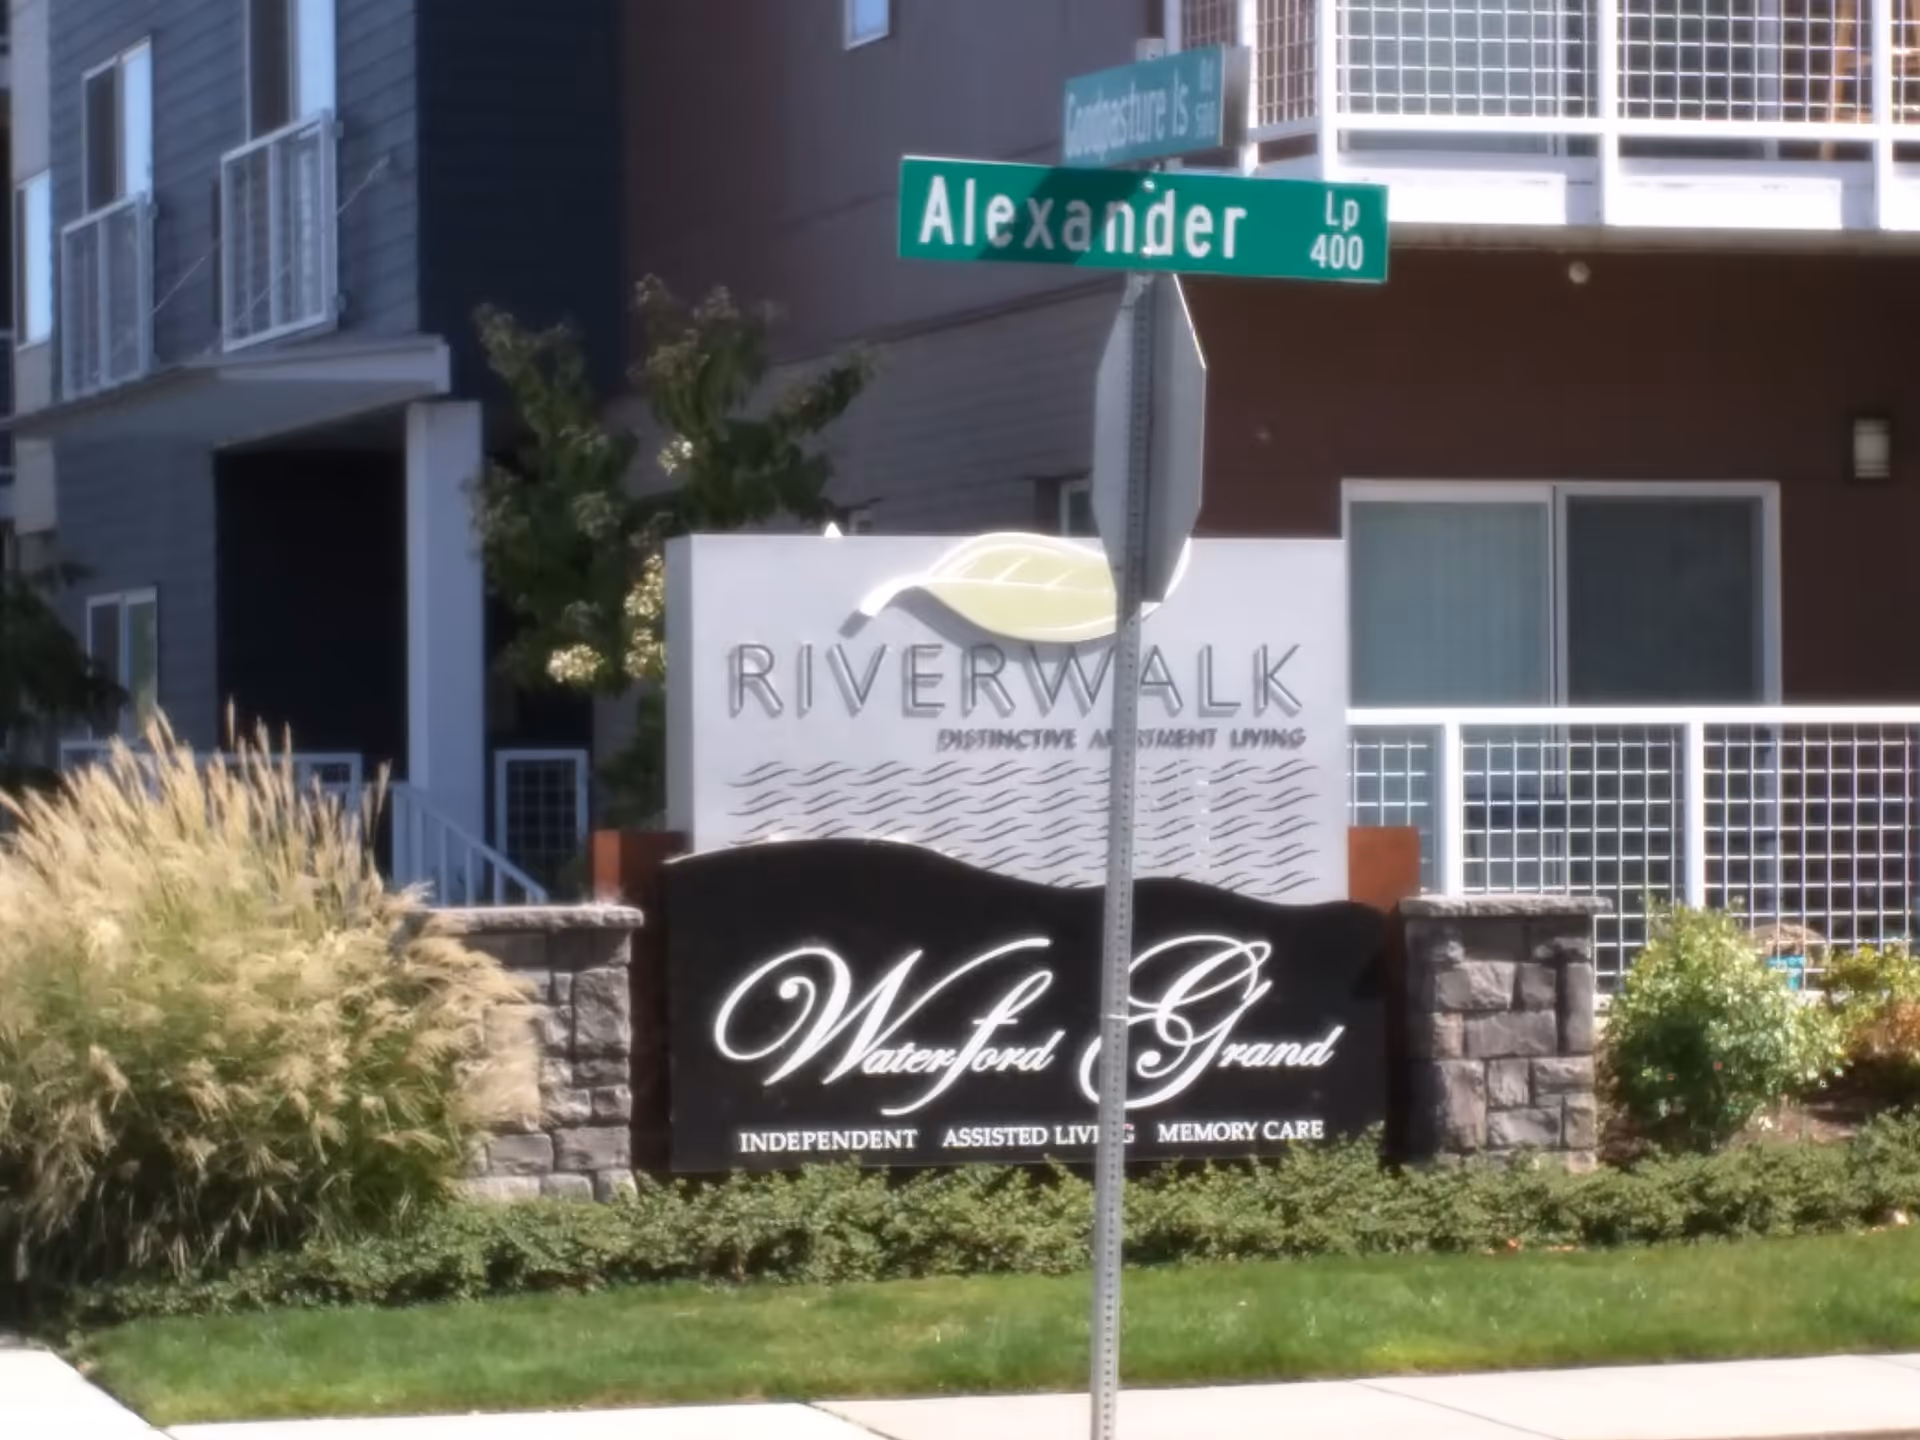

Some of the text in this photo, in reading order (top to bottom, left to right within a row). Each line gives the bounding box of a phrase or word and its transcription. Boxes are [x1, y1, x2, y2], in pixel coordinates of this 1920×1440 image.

[1173, 66, 1189, 138] Is
[918, 175, 1247, 259] Alexander
[1325, 190, 1360, 231] Lp
[1310, 234, 1364, 271] 400
[729, 643, 1302, 717] RIVERWALK
[936, 728, 1307, 751] DISTINCTIVE APRTMENT LIVING
[714, 934, 1346, 1115] Waterford Grand
[739, 1119, 1325, 1153] INDEPENDENT ASSISTED LIVIG MEMORY CARE
